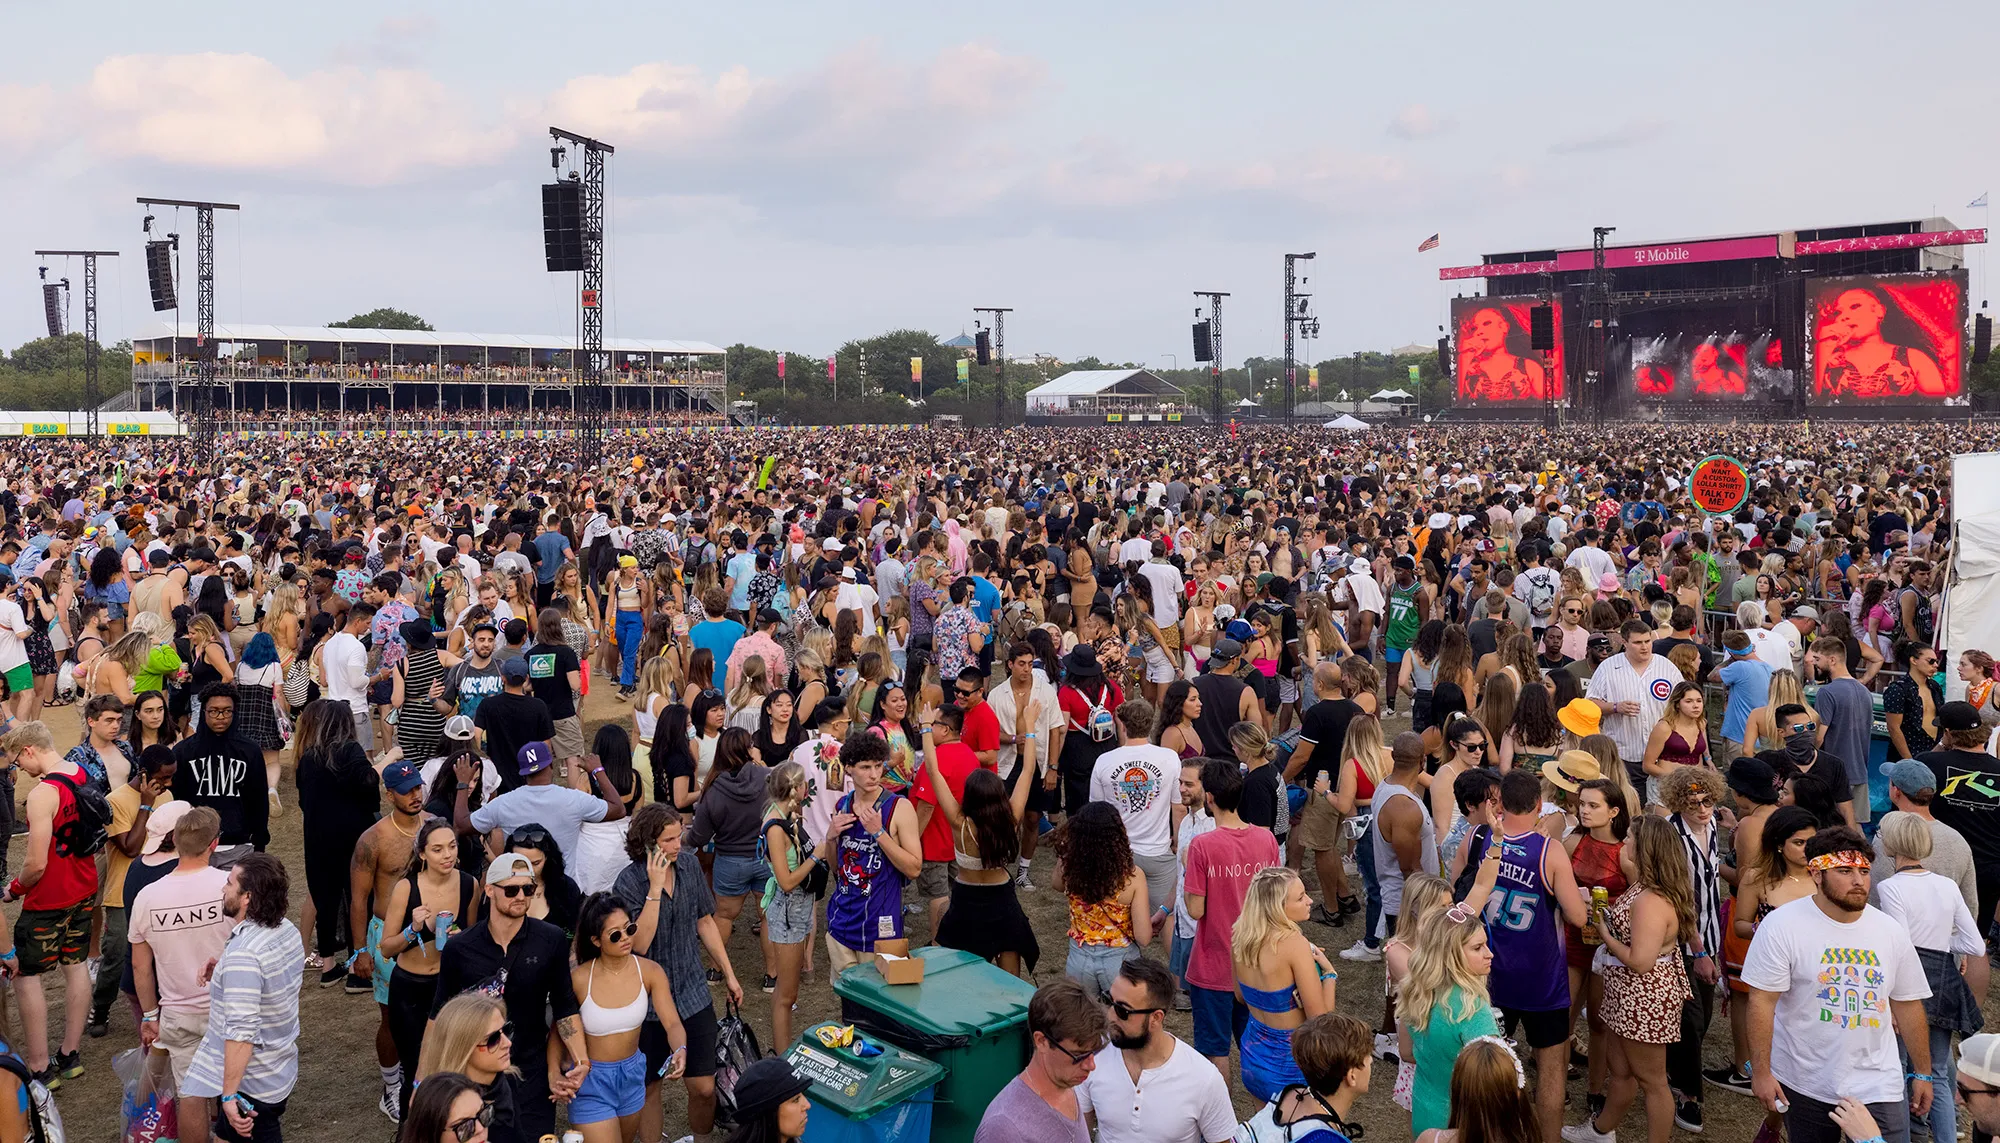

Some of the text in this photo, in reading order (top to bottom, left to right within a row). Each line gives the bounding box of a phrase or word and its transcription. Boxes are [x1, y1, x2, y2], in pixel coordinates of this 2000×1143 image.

[1647, 247, 1690, 263] Mobile
[582, 294, 597, 303] W3
[32, 423, 59, 434] BAR
[116, 423, 141, 434] BAR
[1708, 474, 1738, 484] CUSTOM
[1711, 468, 1732, 477] WANT
[1696, 480, 1742, 491] LOLLA SHIRT?
[1700, 488, 1736, 500] TALK TO
[1708, 497, 1725, 507] ME!
[1391, 604, 1408, 621] 77
[526, 748, 538, 763] N
[188, 754, 247, 797] VAMP
[1110, 760, 1163, 780] NCAA SWEET SIXTEEN
[866, 853, 882, 870] 15
[155, 905, 218, 927] VANS
[1485, 885, 1541, 932] 45
[1819, 1007, 1880, 1031] Dayglow
[797, 1056, 825, 1073] PLASTIC
[822, 1067, 853, 1086] BOTTLES
[798, 1065, 844, 1091] ALUMINUM CANS
